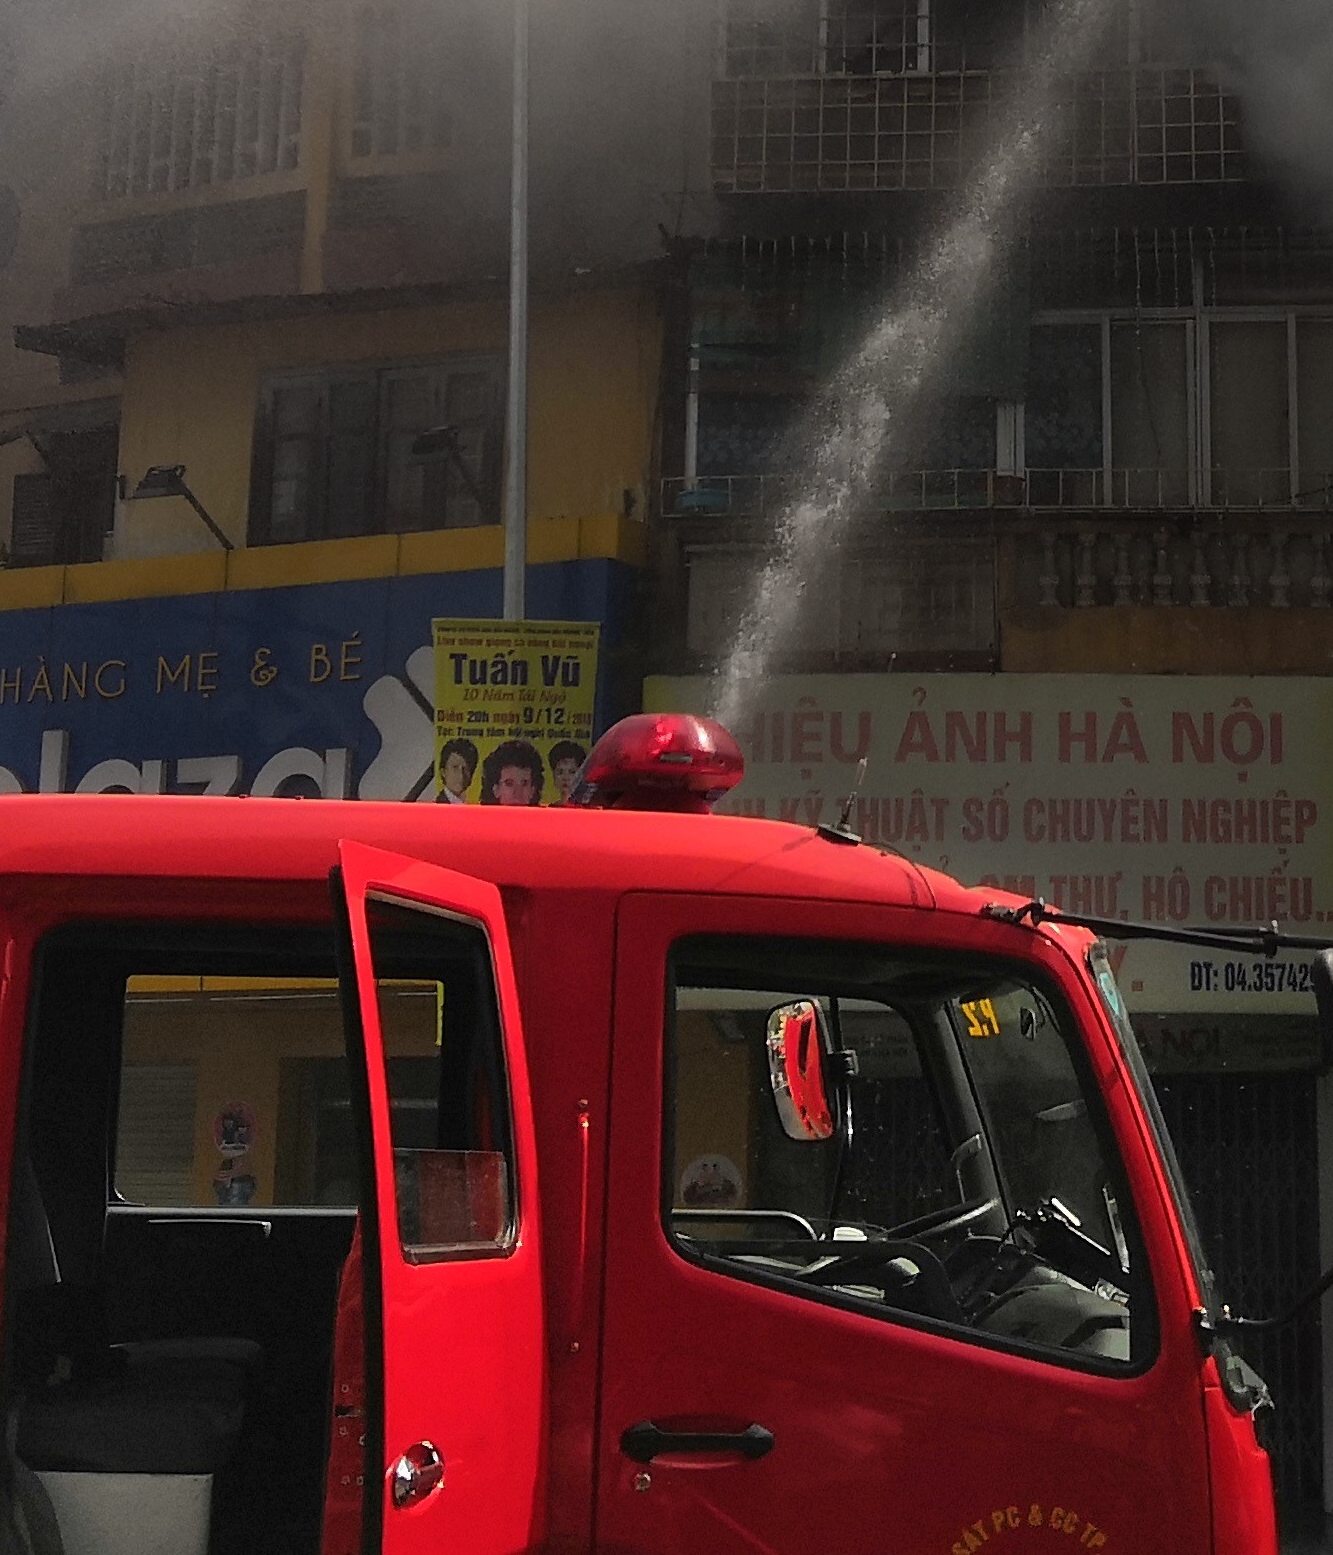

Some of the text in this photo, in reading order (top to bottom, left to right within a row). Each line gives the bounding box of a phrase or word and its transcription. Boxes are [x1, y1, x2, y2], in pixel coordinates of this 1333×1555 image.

[0, 655, 127, 704] HÀNG
[156, 652, 219, 698] MẸ
[250, 647, 278, 687] &
[308, 630, 364, 683] BÉ
[449, 650, 581, 687] Tuấn Vũ
[894, 686, 1033, 763] ẢNH
[1058, 697, 1150, 765] HÀ
[1172, 697, 1284, 783] NỘI
[961, 782, 1010, 844] SỐ
[1023, 787, 1169, 844] CHUYÊN
[1182, 790, 1318, 855] NGHIỆP
